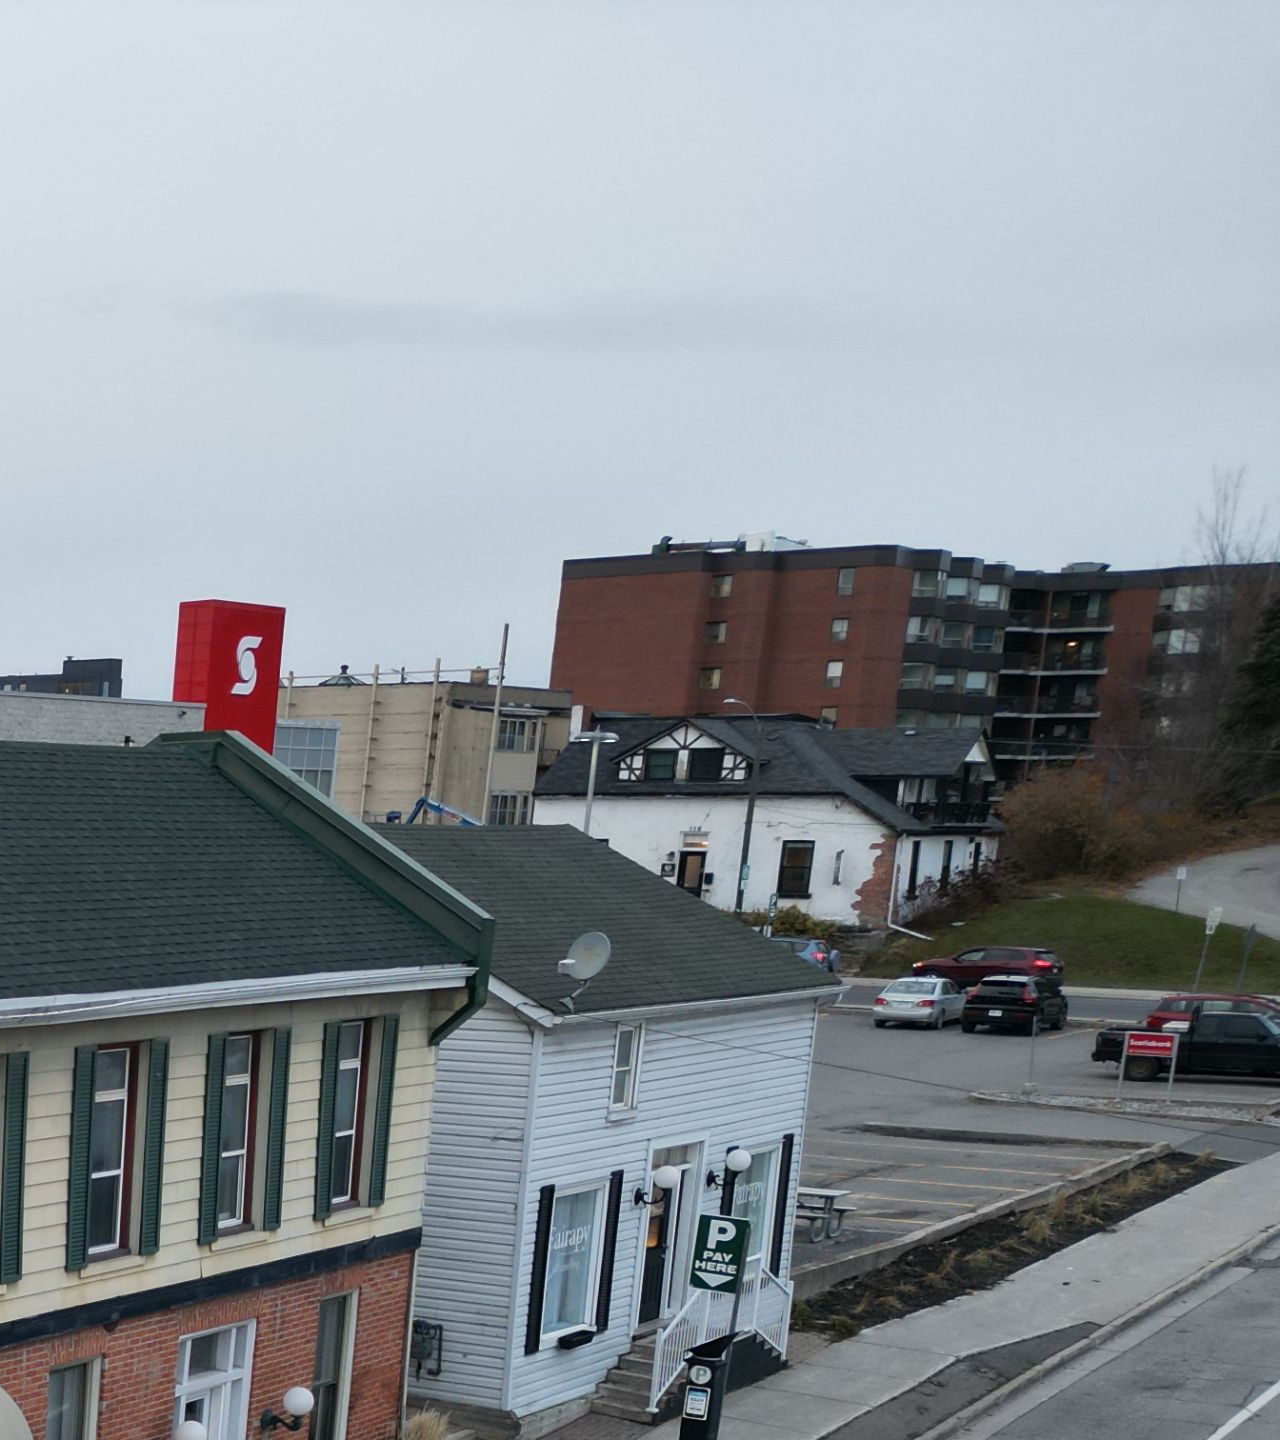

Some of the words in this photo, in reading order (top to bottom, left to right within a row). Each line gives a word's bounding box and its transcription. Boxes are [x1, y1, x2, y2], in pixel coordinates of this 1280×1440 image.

[707, 1219, 737, 1250] P
[703, 1250, 734, 1263] PAY
[694, 1260, 738, 1275] HERE
